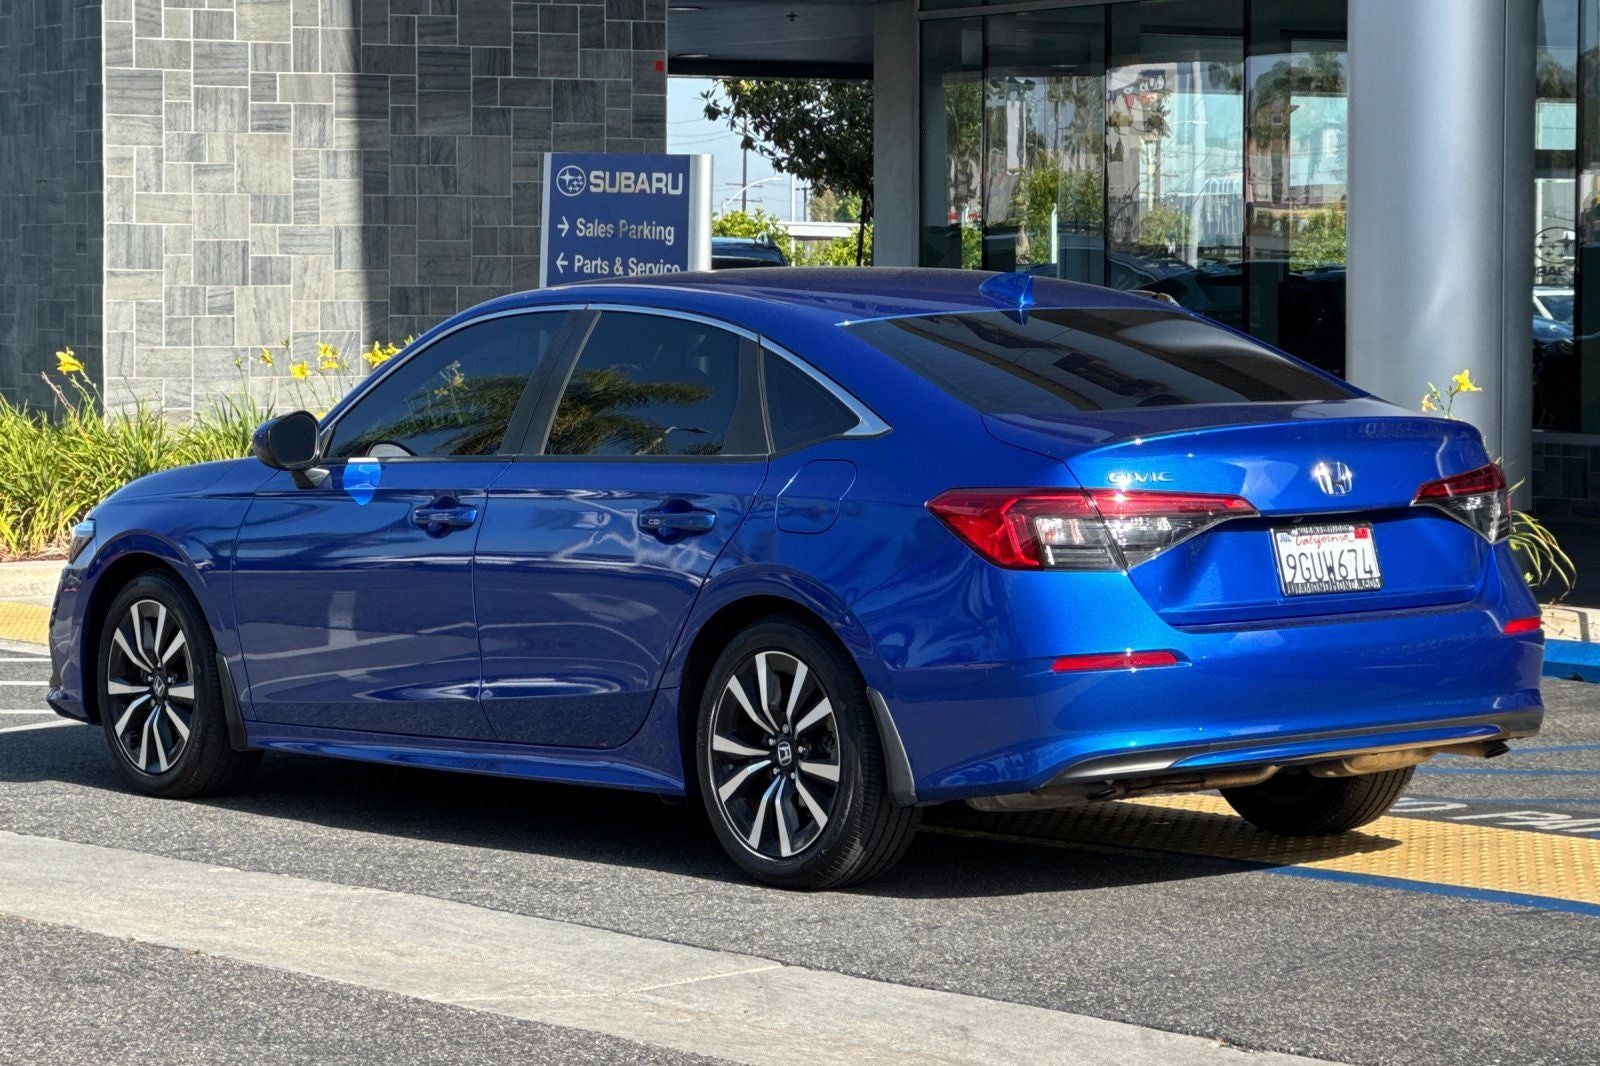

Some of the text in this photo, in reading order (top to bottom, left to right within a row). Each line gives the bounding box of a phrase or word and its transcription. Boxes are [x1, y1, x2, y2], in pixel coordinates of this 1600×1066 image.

[589, 170, 683, 195] SUBARU
[576, 217, 675, 246] Sales Parking
[574, 254, 609, 275] Parts
[613, 256, 624, 276] &
[1107, 471, 1175, 483] CIVIC
[1295, 533, 1354, 549] California
[1286, 548, 1374, 582] 9GUW674
